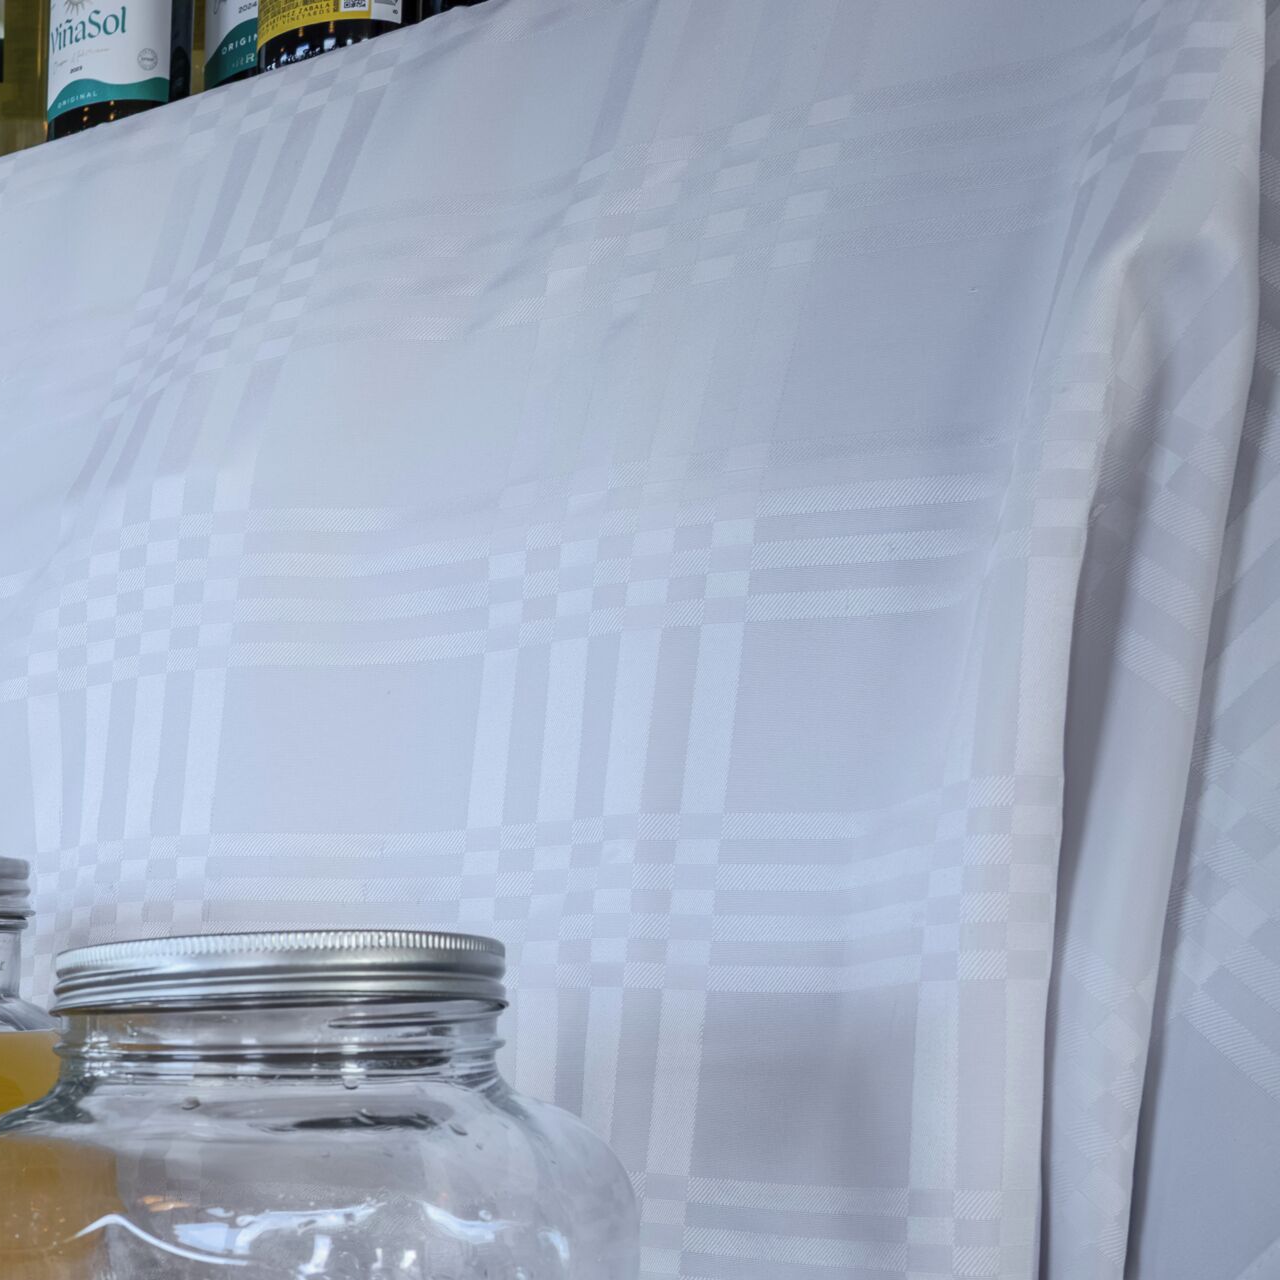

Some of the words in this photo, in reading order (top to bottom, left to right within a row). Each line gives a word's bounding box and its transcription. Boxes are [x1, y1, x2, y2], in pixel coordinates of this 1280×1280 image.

[298, 3, 330, 14] ZABALA
[51, 6, 127, 55] ViñaSol
[57, 91, 98, 109] ORIGINAL
